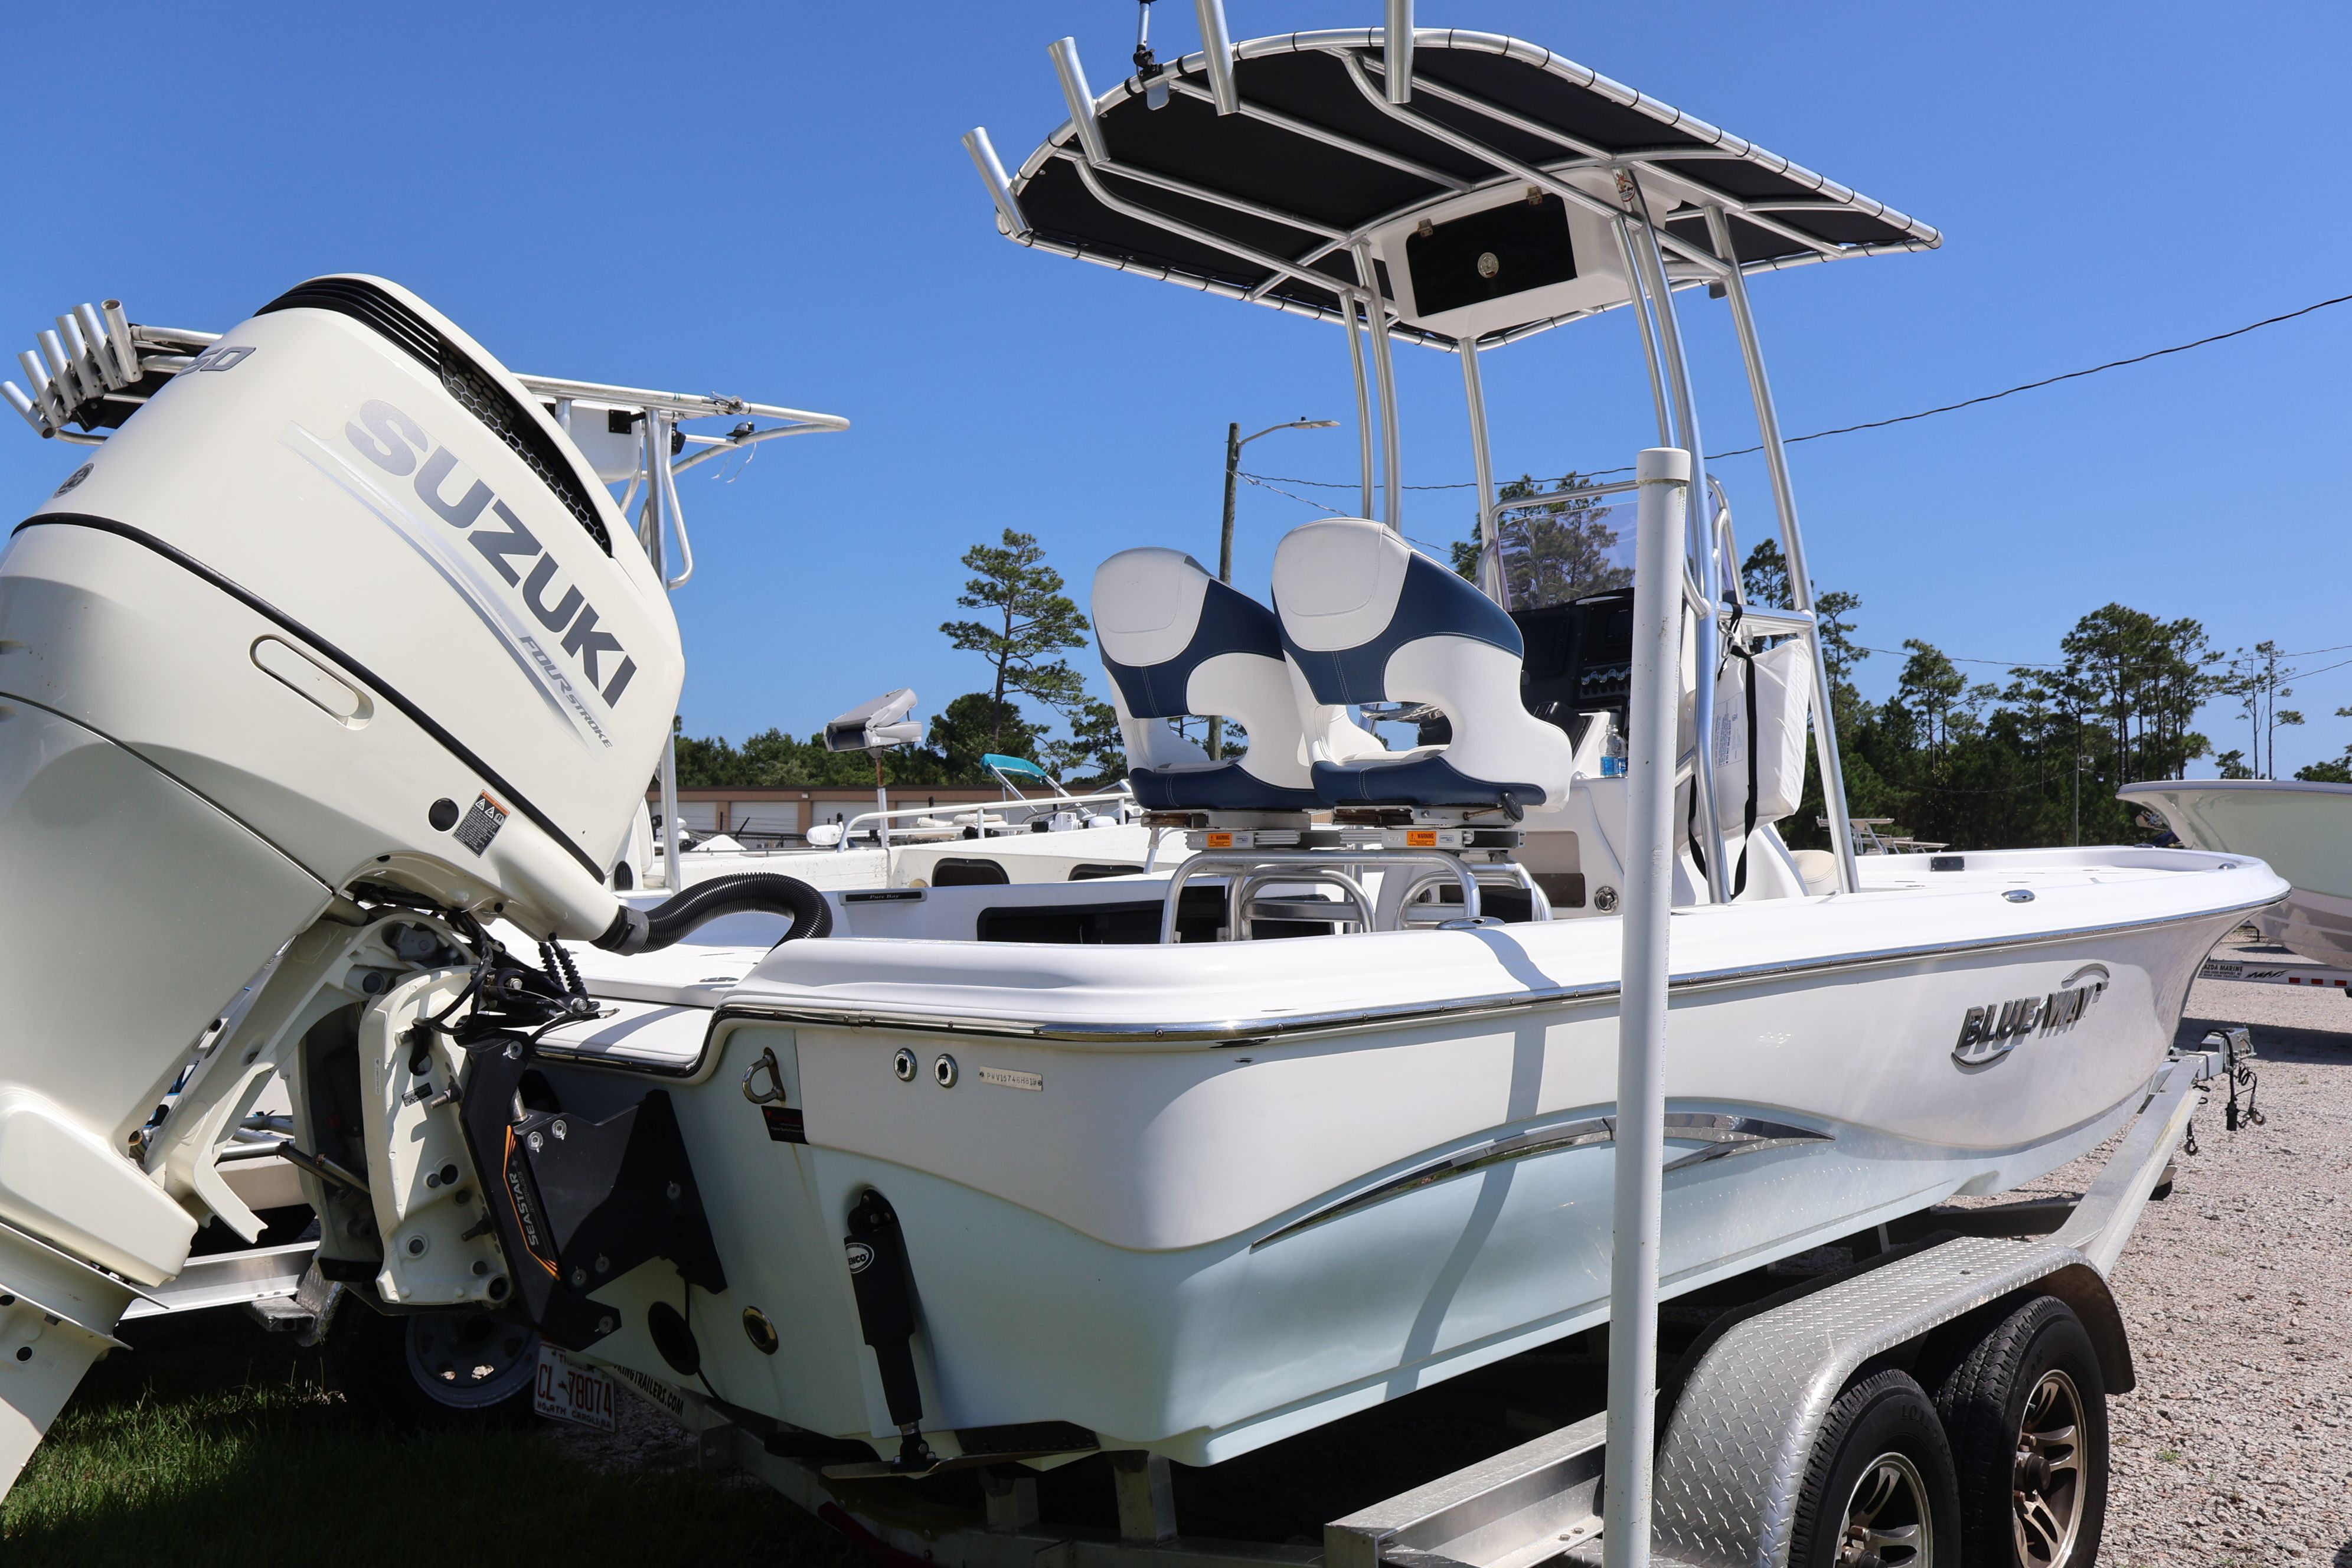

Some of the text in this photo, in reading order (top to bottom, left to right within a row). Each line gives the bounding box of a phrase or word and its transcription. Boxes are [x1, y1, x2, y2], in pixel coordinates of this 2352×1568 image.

[175, 347, 257, 378] 50
[345, 399, 637, 709] SUZUKI
[520, 635, 614, 749] FOUR STROKE
[1955, 996, 2041, 1050] BLUE
[509, 1172, 539, 1246] SEASTAR
[848, 1253, 867, 1265] ENCO
[537, 1401, 612, 1429] NORTH CAROLINA
[613, 1365, 684, 1417] KINGTRAILERS.COM
